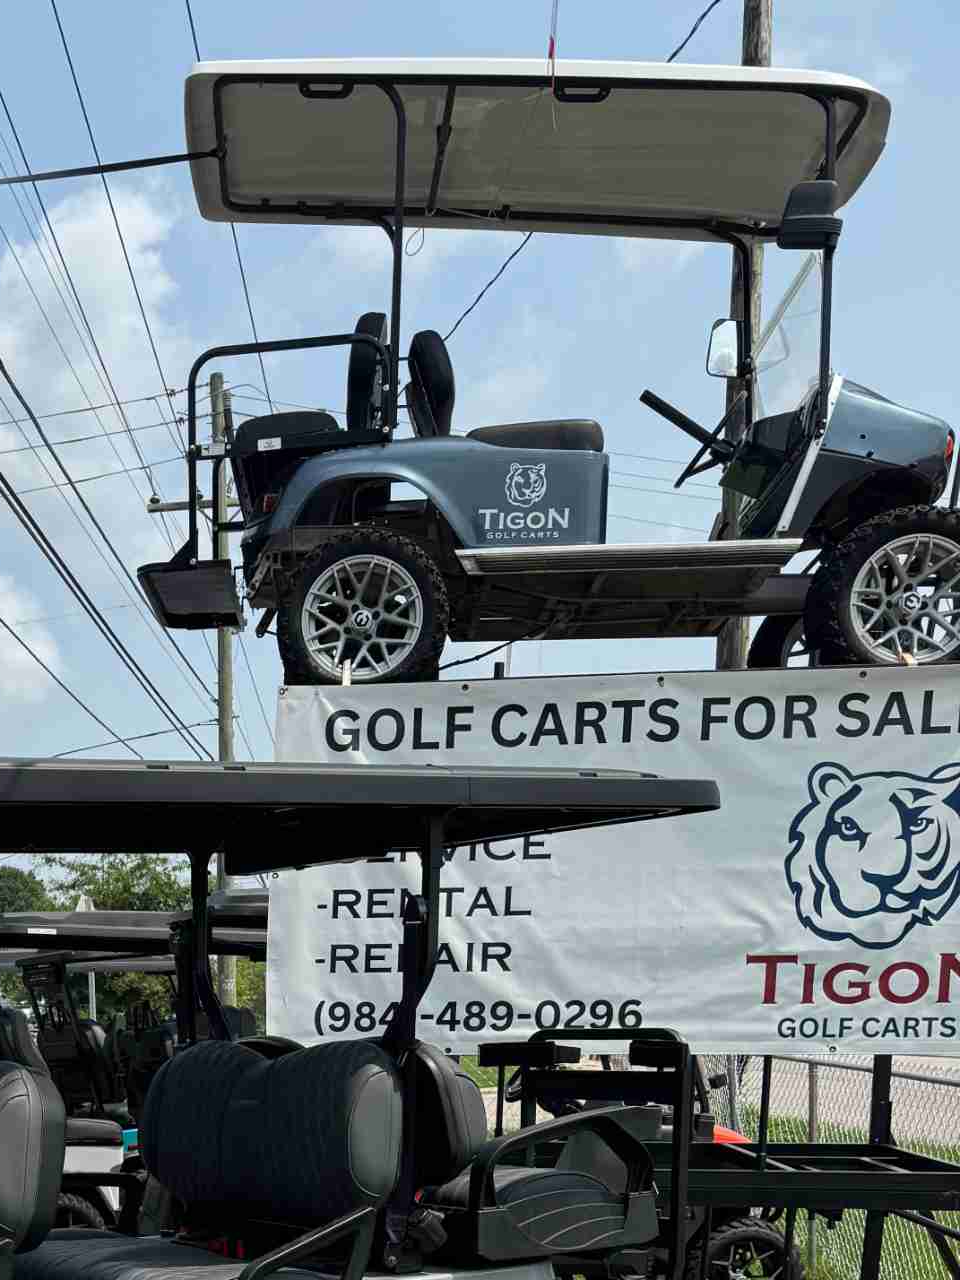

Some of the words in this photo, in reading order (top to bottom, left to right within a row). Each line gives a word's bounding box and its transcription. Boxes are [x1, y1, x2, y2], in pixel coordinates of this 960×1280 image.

[478, 507, 571, 530] TIGON
[486, 532, 517, 540] GOLF
[520, 531, 560, 539] CARTS
[325, 706, 474, 752] GOLF
[491, 698, 681, 746] CARTS
[701, 695, 819, 741] FOR
[835, 690, 960, 738] SAL
[314, 942, 512, 974] -REAIR
[313, 999, 643, 1036] (984-489-0296
[777, 1017, 854, 1039] GOLF
[861, 1017, 957, 1038] CARTS
